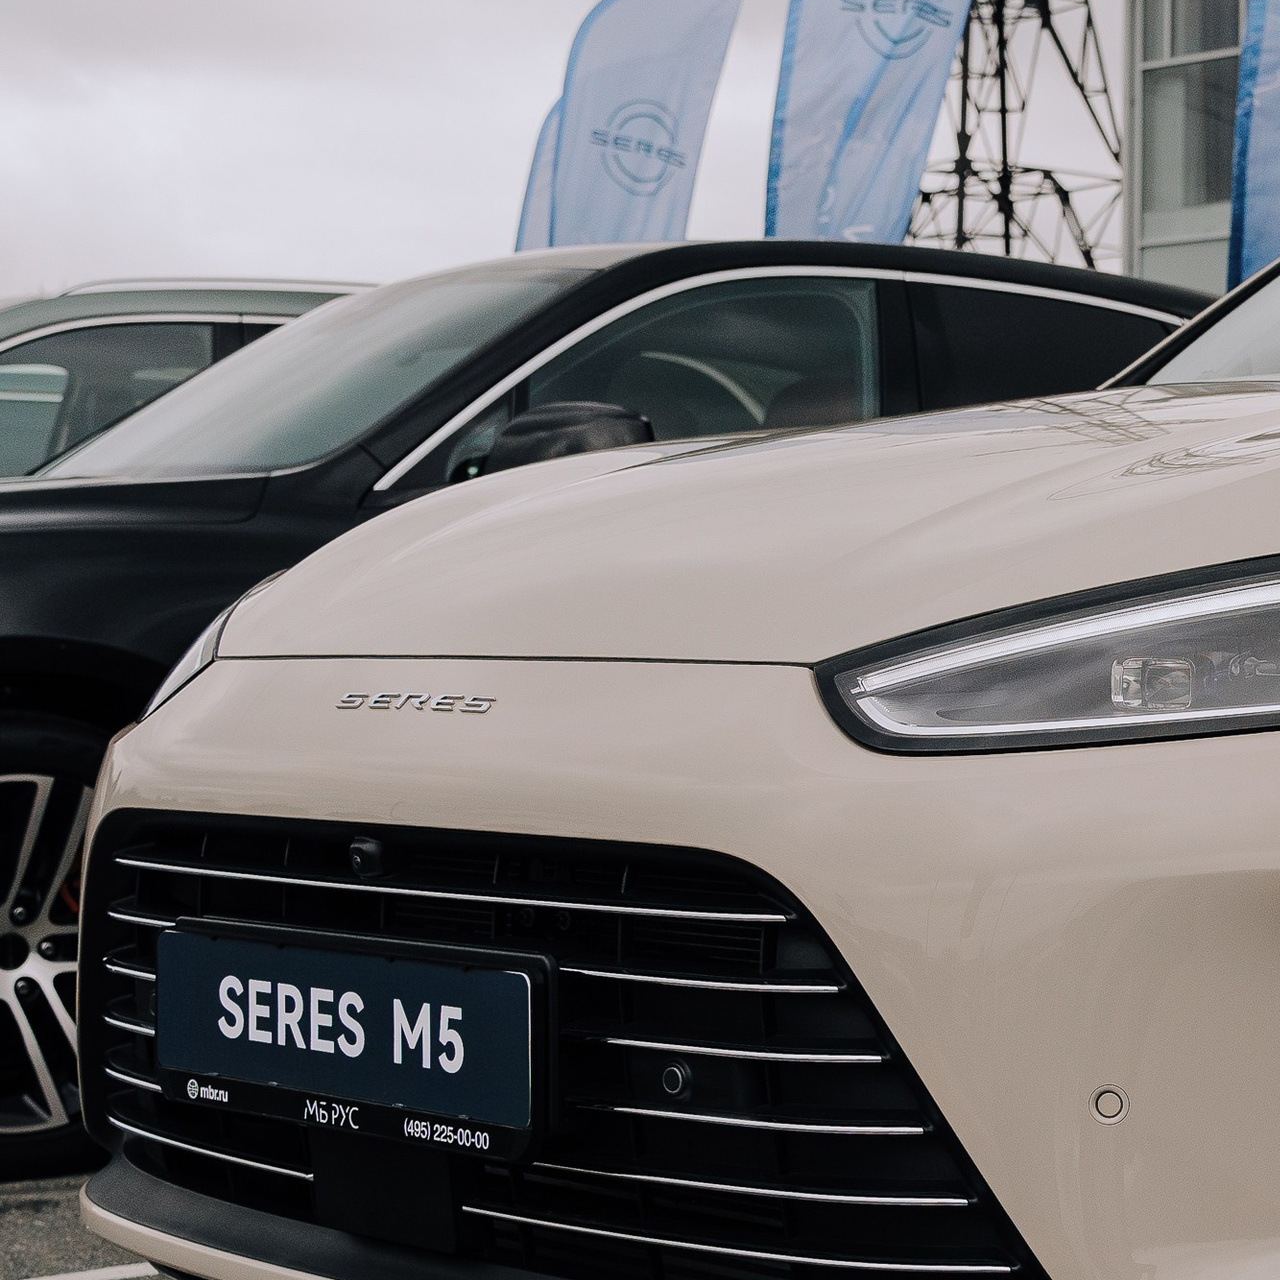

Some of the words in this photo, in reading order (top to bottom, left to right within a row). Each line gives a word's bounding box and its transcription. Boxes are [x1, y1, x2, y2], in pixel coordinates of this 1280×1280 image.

[335, 692, 498, 714] SERES
[218, 975, 366, 1058] SERES
[393, 998, 465, 1074] M5
[200, 1085, 229, 1103] mbr.ru
[404, 1117, 431, 1140] (495)
[433, 1123, 490, 1150] 225-00-00
